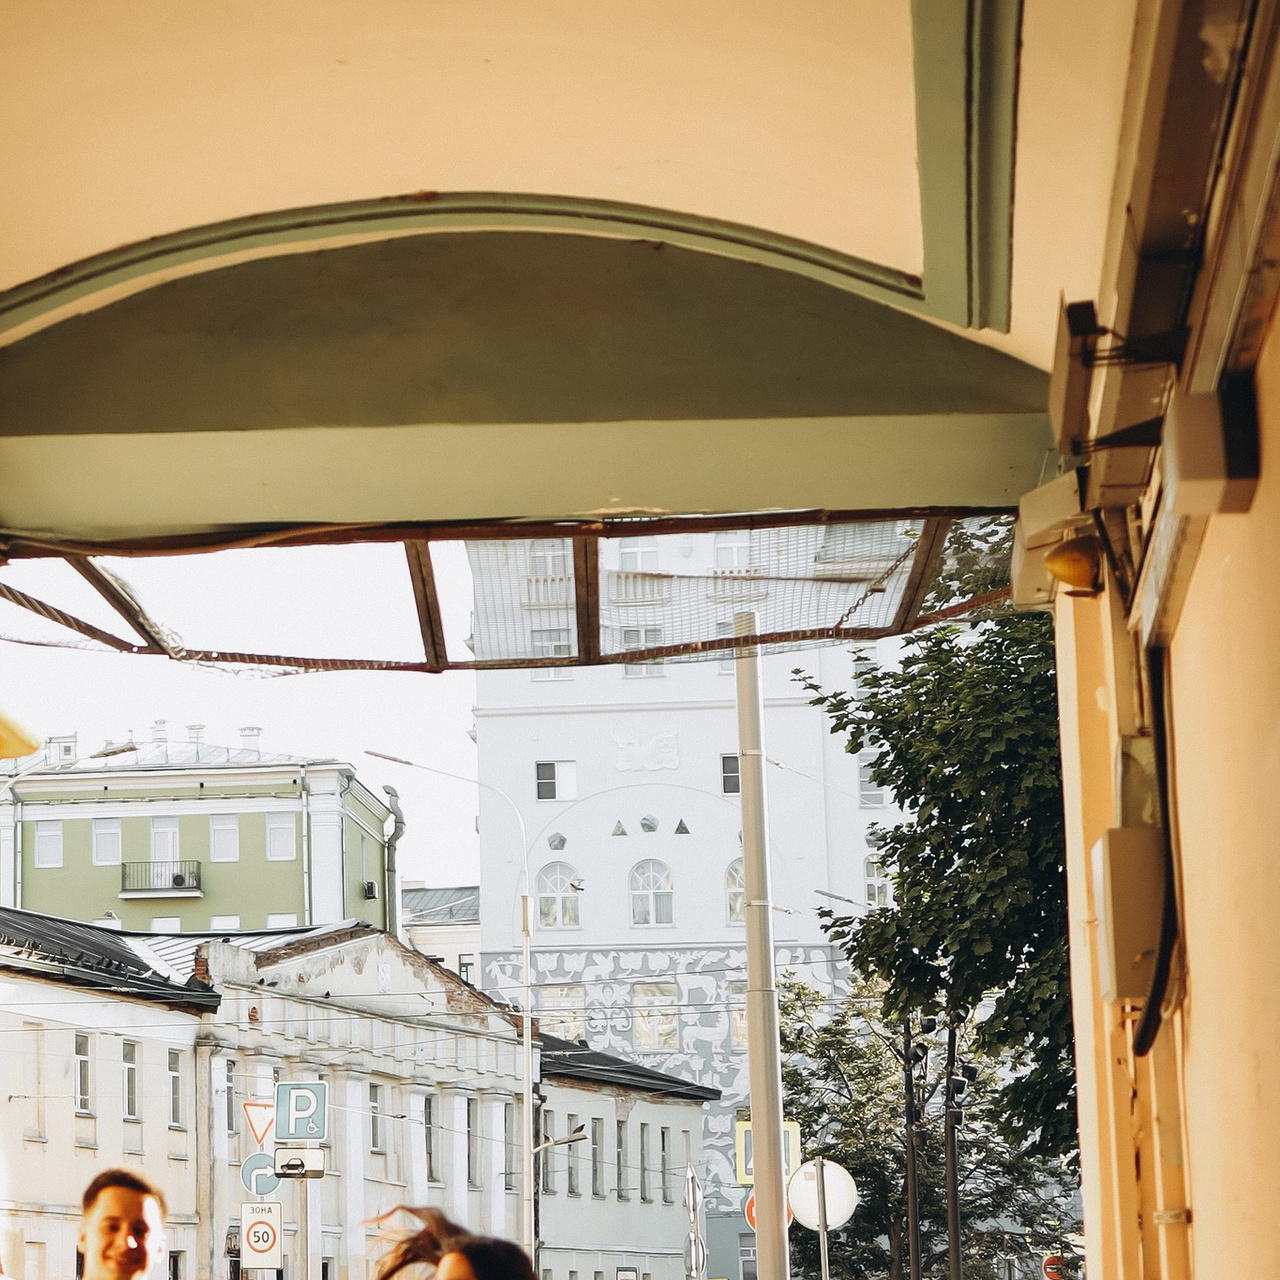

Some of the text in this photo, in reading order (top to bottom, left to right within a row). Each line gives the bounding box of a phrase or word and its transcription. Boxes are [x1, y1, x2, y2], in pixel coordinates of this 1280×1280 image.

[288, 1088, 317, 1135] P
[249, 1206, 273, 1214] ЗОНА
[253, 1230, 270, 1243] 50
